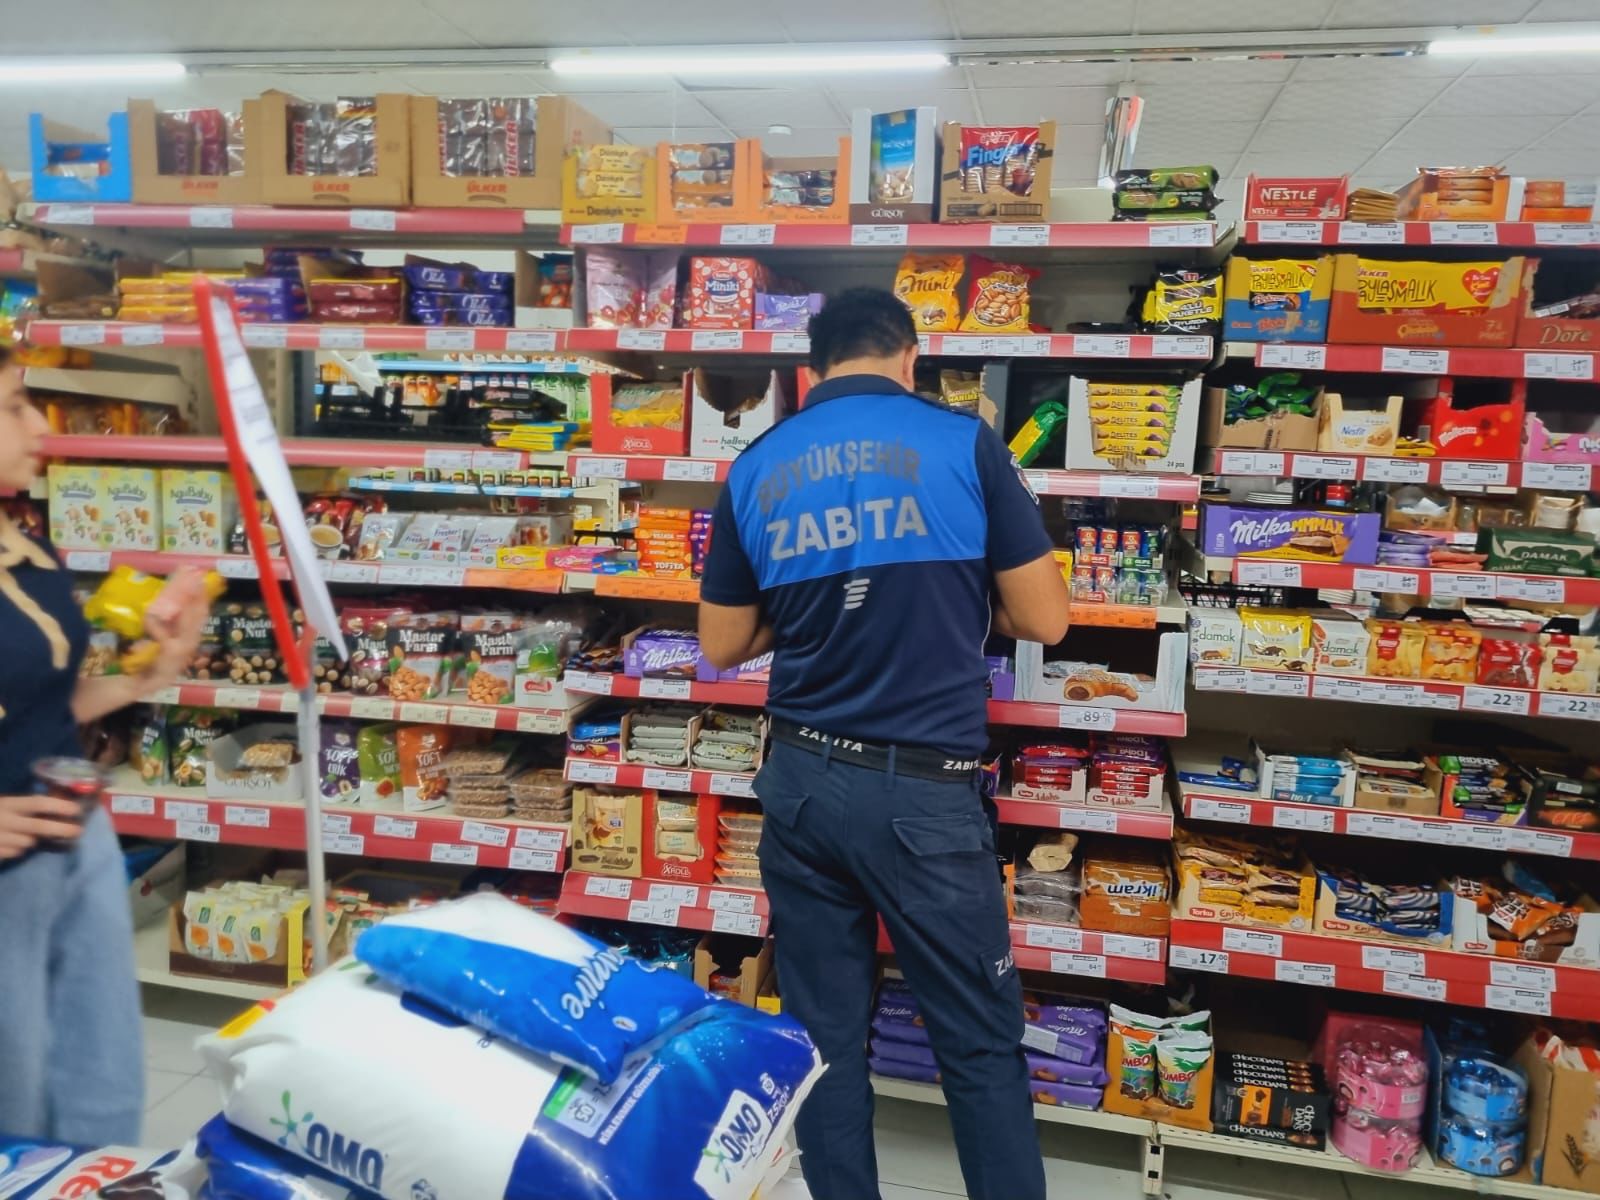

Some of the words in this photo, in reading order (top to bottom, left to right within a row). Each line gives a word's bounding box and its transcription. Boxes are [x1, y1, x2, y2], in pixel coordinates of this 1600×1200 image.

[1260, 187, 1318, 202] NESTLÉ
[871, 206, 904, 220] GÜRSOY
[1540, 325, 1593, 344] Dore
[721, 436, 750, 452] halley
[766, 496, 929, 561] ZABITA
[1229, 517, 1292, 545] Milka
[1520, 551, 1568, 562] DAMAK
[1199, 627, 1236, 643] damak
[1323, 641, 1360, 654] damak
[642, 647, 693, 668] Milka
[1083, 711, 1100, 723] 89
[1107, 881, 1158, 897] ikram
[1191, 909, 1214, 918] Torku
[1219, 909, 1246, 921] Enjoy
[1325, 921, 1349, 930] Torku
[879, 1006, 913, 1017] Milka
[720, 1102, 762, 1163] OMO
[306, 1122, 384, 1191] OMO
